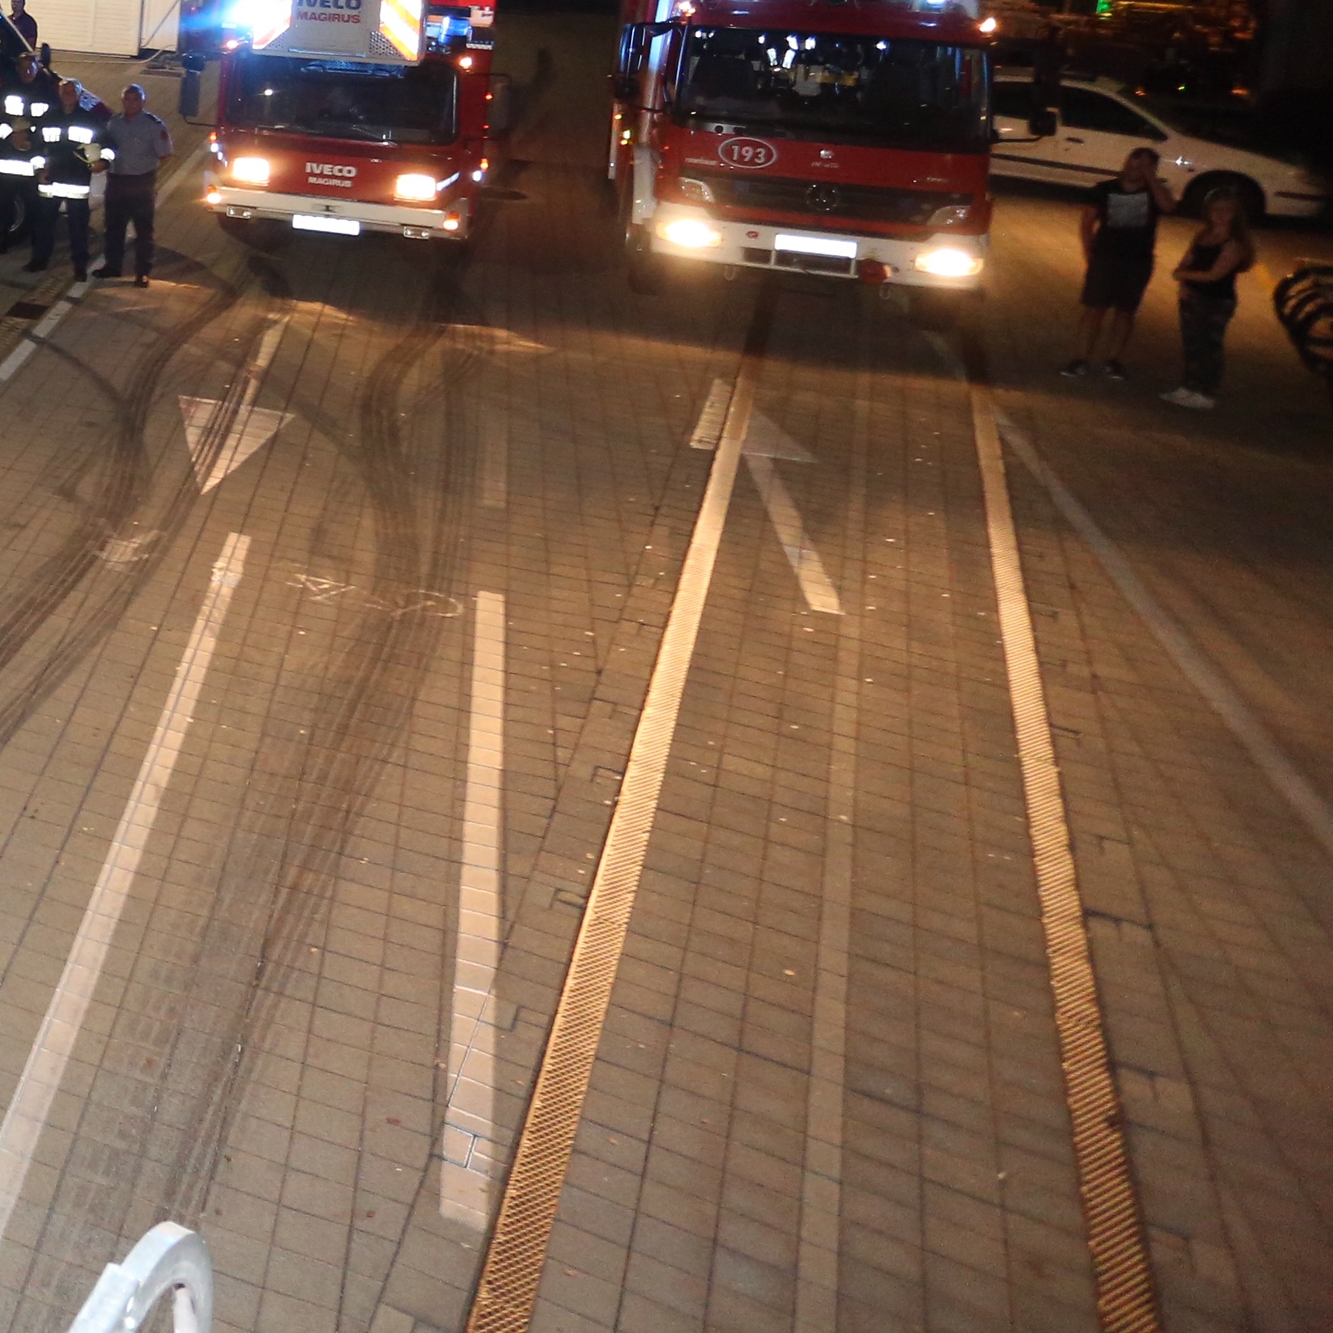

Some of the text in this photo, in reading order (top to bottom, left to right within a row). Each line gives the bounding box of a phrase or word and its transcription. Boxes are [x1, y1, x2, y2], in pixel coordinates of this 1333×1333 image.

[297, 11, 361, 24] MAGIRUS
[731, 145, 766, 164] 193
[305, 162, 357, 178] IVECO
[308, 176, 353, 188] MAGIRUS
